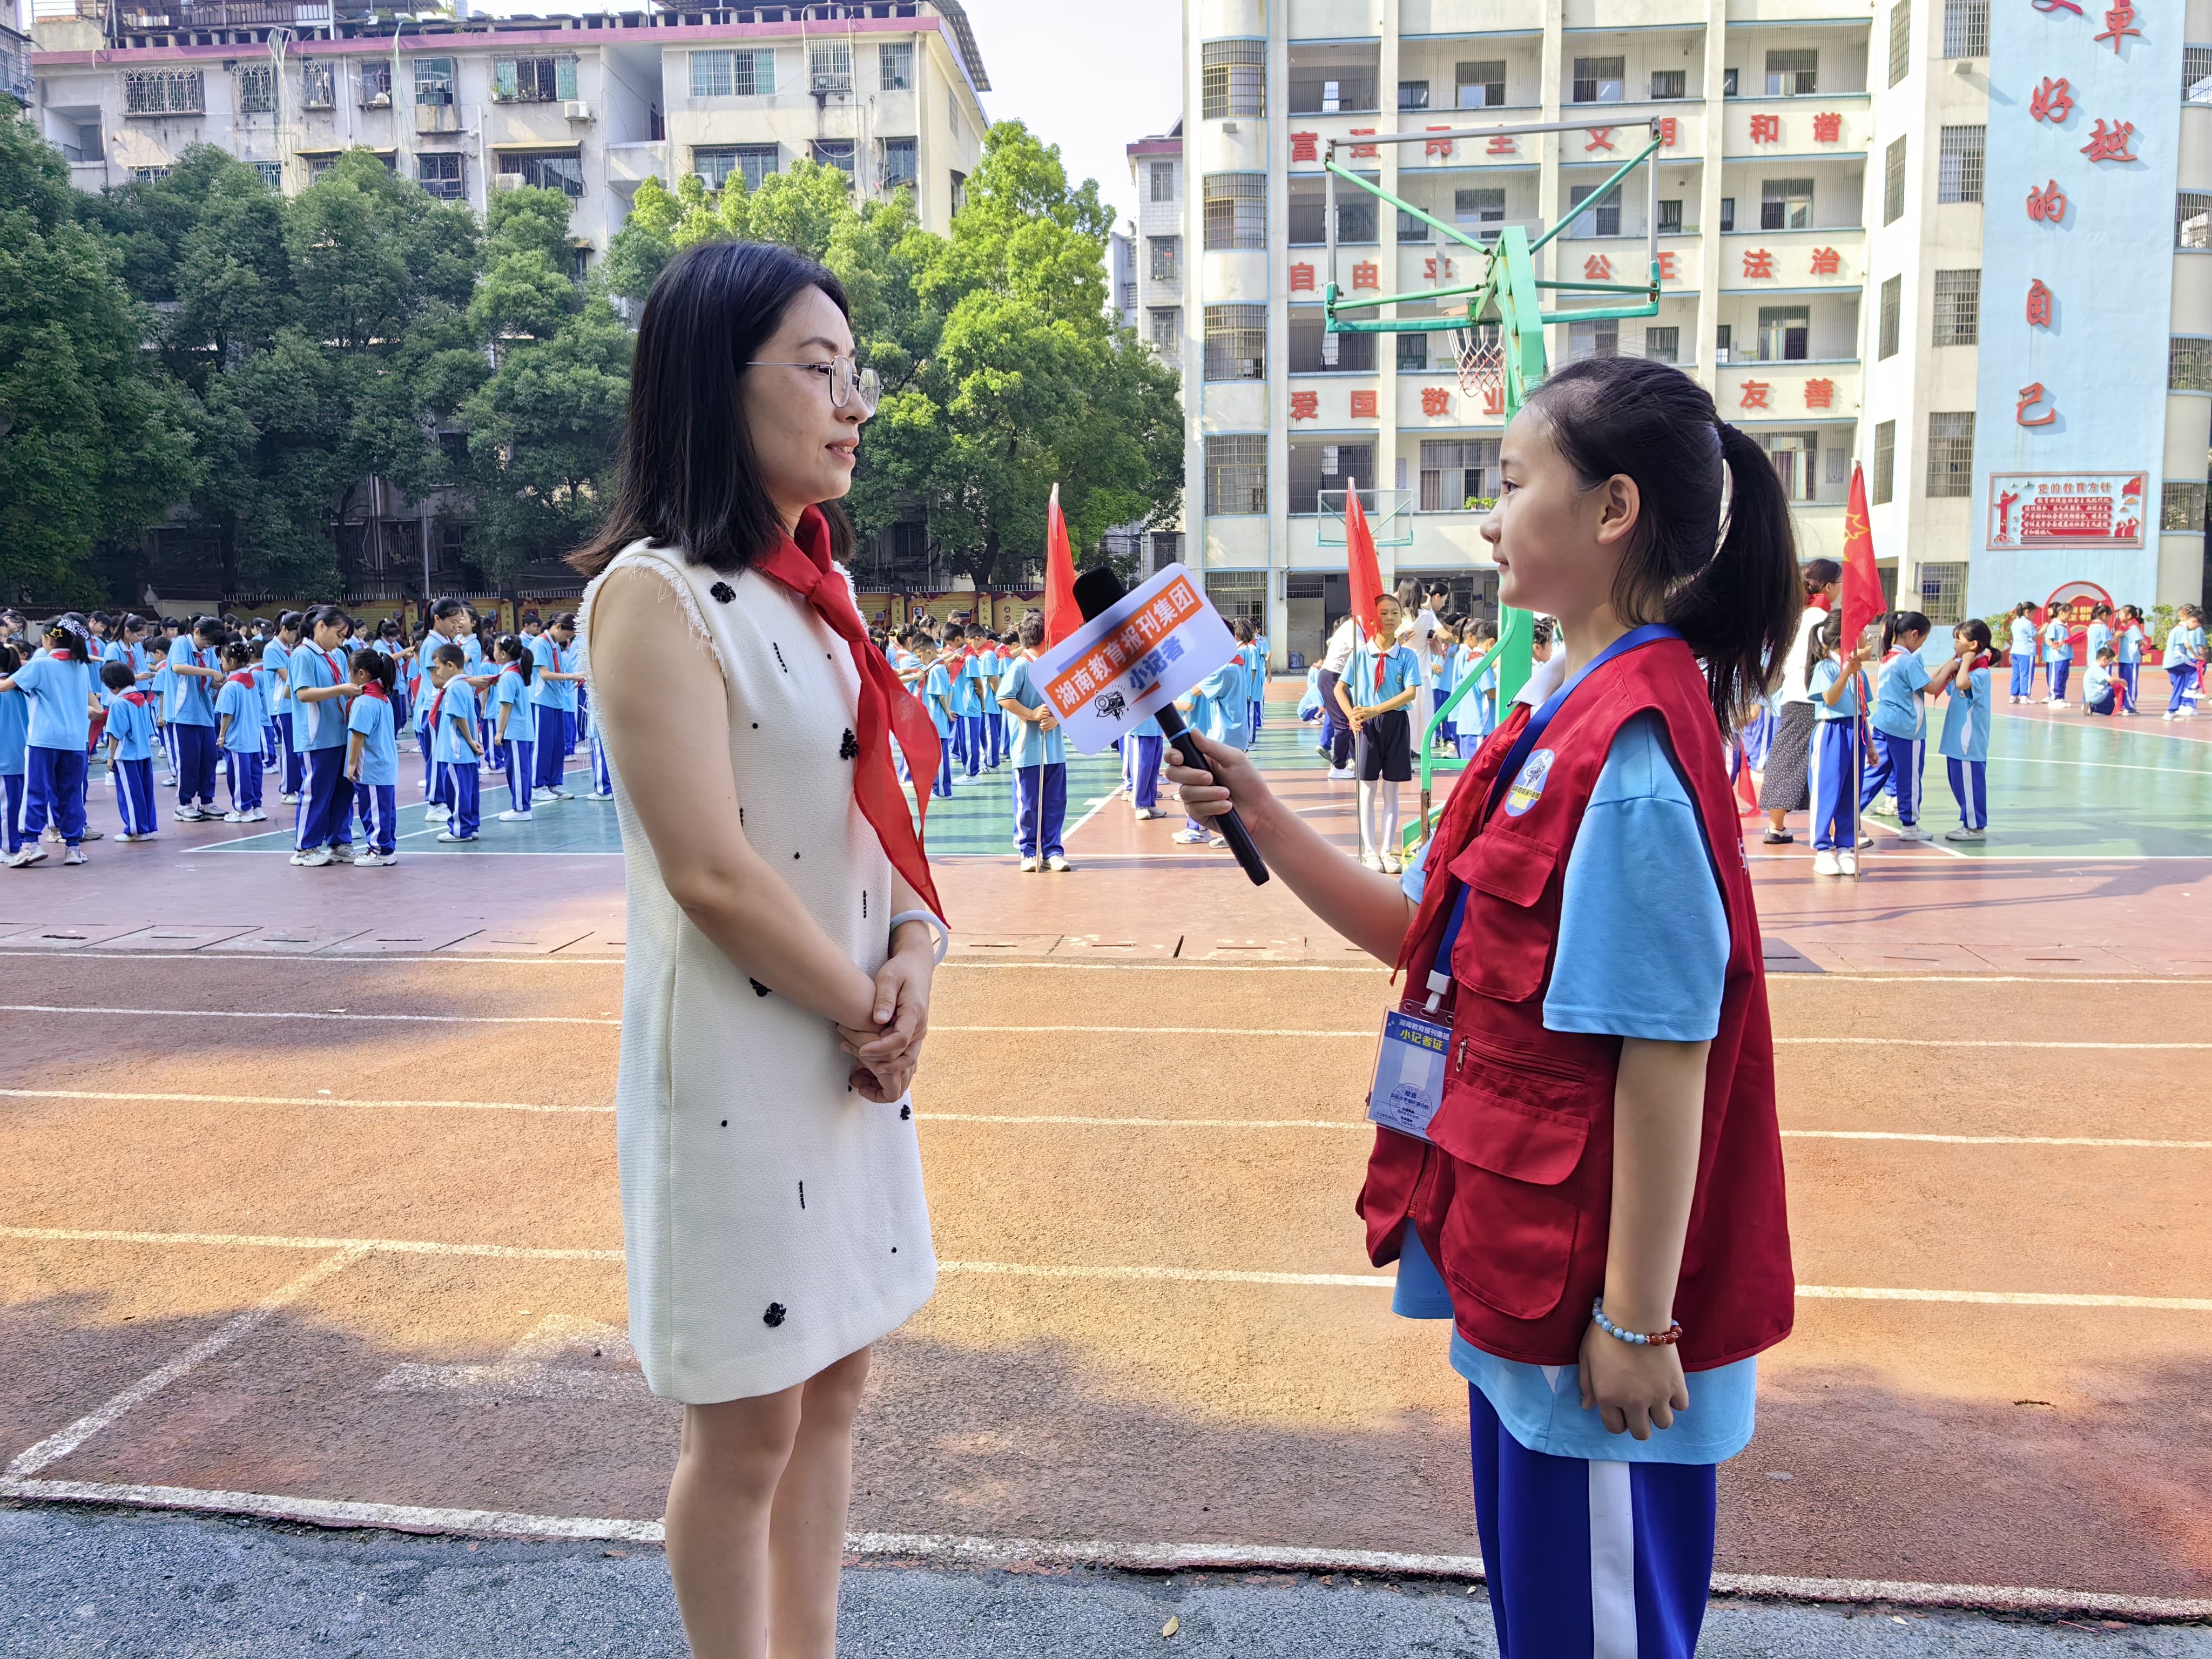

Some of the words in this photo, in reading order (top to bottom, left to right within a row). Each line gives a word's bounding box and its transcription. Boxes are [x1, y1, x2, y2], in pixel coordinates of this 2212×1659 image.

[1291, 129, 1377, 161] 富强
[1425, 124, 1515, 156] 民主
[1750, 112, 1841, 144] 和谐
[2016, 0, 2083, 426] 好的自己
[1291, 260, 1377, 291] 自由
[1743, 247, 1840, 278] 法治
[1290, 390, 1377, 420] 爱国
[1421, 387, 1505, 417] 敬业
[1740, 378, 1834, 409] 友善
[2038, 481, 2111, 494] 党的教育方针
[1055, 582, 1196, 710] 湖南教育报刊集团
[1130, 636, 1185, 690] 小记者
[1400, 1029, 1444, 1051] 小记者证
